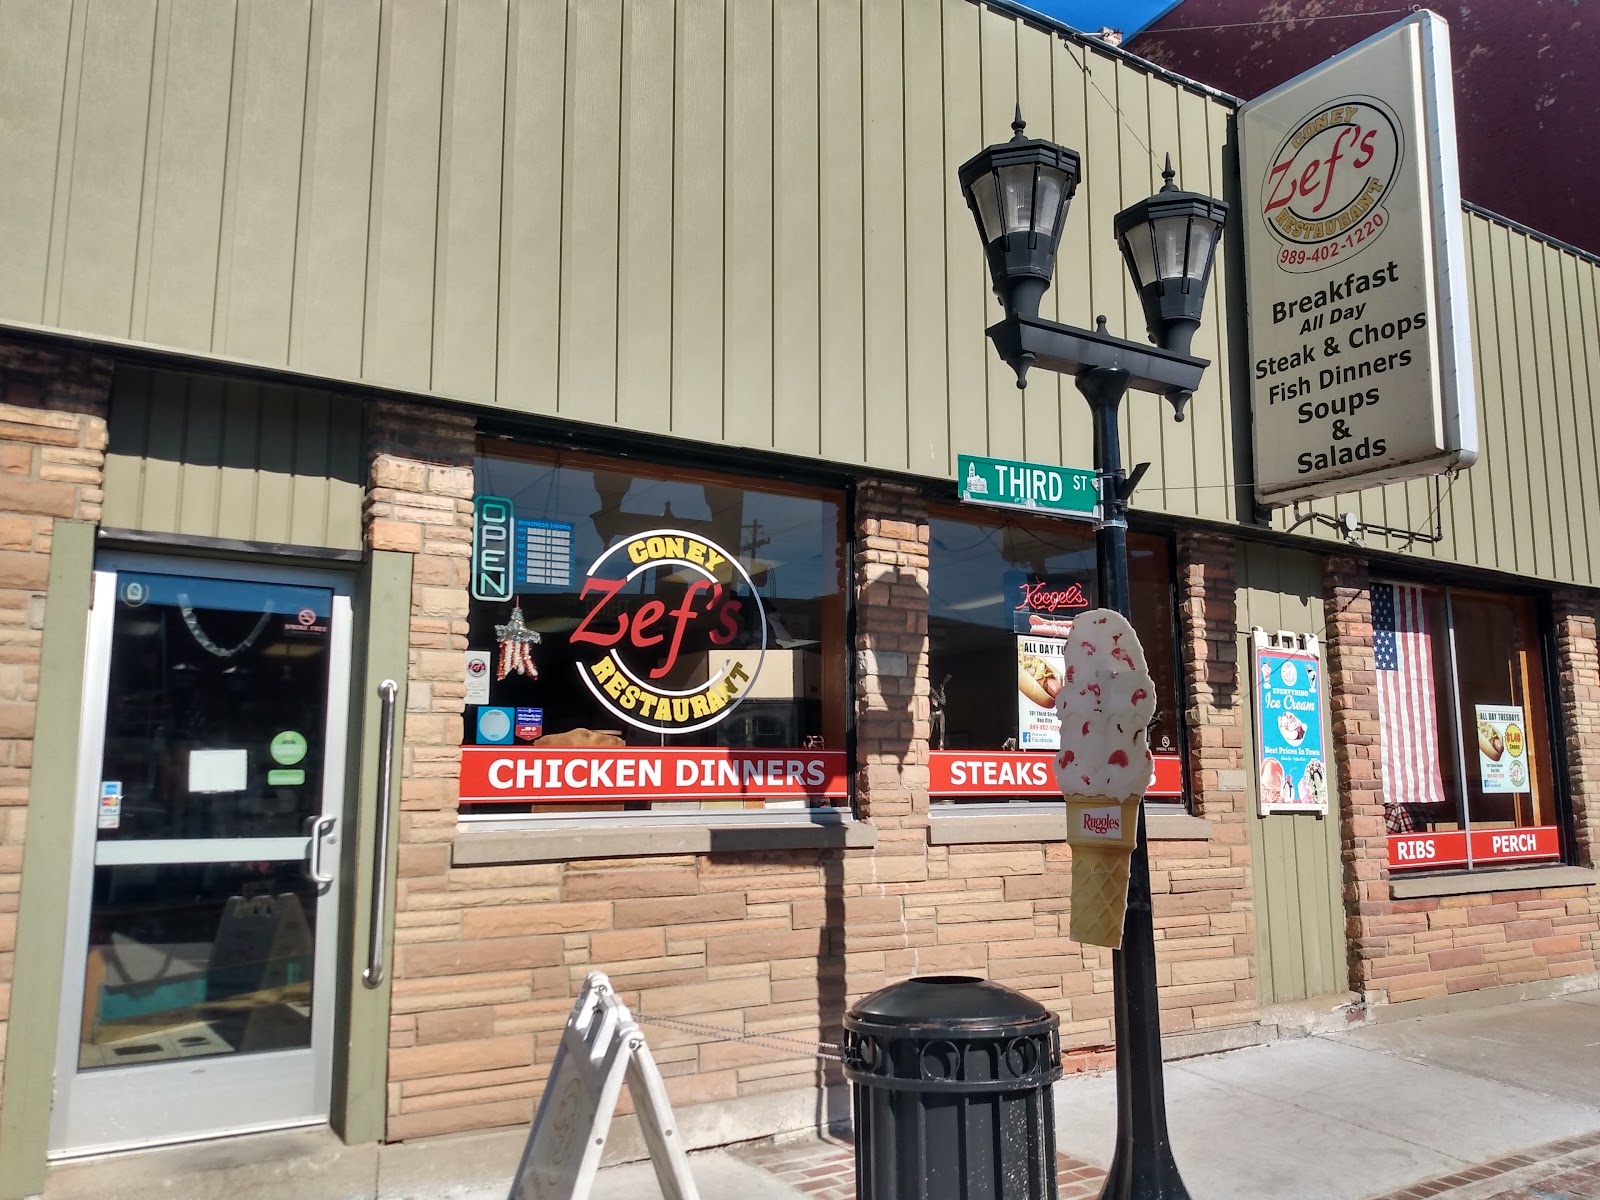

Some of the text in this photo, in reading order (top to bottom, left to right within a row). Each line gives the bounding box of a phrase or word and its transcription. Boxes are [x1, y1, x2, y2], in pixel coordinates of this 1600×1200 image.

[1291, 106, 1359, 149] CONEY
[1264, 124, 1377, 214] Zef's
[1275, 177, 1384, 239] RESTAURANT
[1280, 213, 1384, 265] 989-402-1220
[1272, 261, 1399, 325] Breakfast
[1299, 302, 1366, 336] All Day
[1255, 312, 1427, 380] Steak & Chops
[1269, 349, 1412, 406] Fish Dinners
[1298, 387, 1380, 424] Soups
[1332, 418, 1352, 441] &
[1297, 436, 1387, 474] Salads
[994, 464, 1088, 502] THIRD ST
[518, 519, 571, 531] BUSINESS HOURS
[480, 503, 507, 596] OPEN
[627, 536, 726, 572] CONEY
[1014, 582, 1089, 612] Koegel's
[569, 576, 742, 679] Zef's
[1024, 642, 1037, 653] ALL
[1039, 643, 1054, 655] DAY
[591, 655, 750, 722] RESTAURANT
[1265, 691, 1316, 711] Ice Cream
[1272, 687, 1309, 697] EVERYTHING
[1480, 712, 1488, 720] ALL
[1498, 713, 1520, 721] TUESDAYS
[1264, 745, 1279, 754] Best
[1279, 746, 1298, 755] Prices
[487, 758, 826, 789] CHICKEN DINNERS
[950, 760, 1048, 786] STEAKS
[1083, 813, 1120, 834] Ruggles
[1397, 839, 1436, 861] RIBS
[1492, 833, 1537, 854] PERCH
